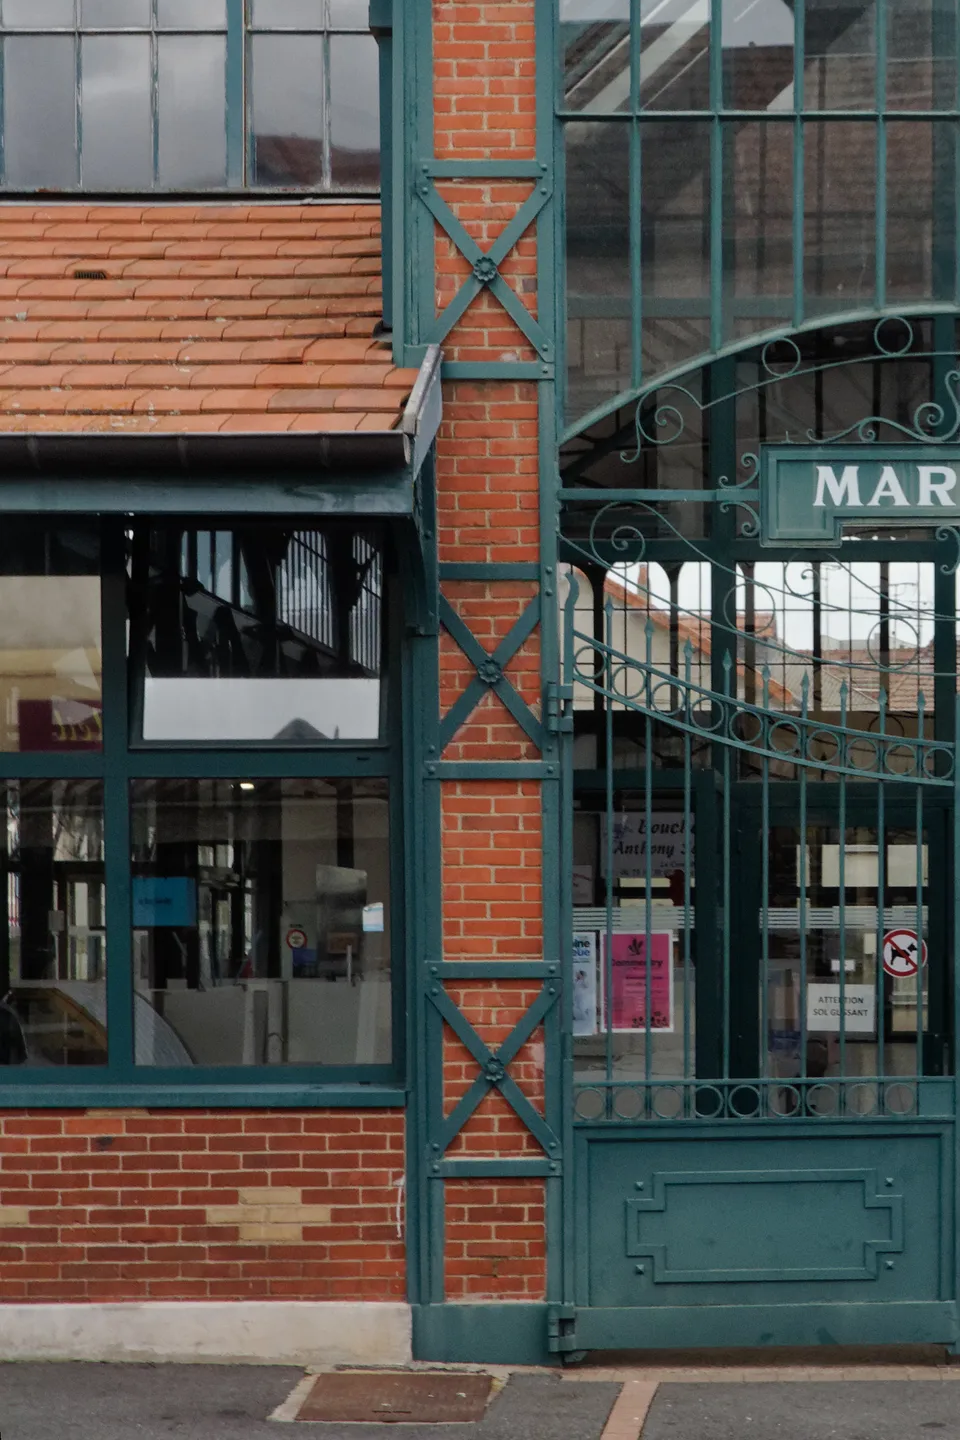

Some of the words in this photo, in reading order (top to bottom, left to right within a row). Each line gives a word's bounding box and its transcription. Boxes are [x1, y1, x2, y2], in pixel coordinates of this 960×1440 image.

[818, 996, 864, 1004] ATTETION
[813, 1008, 828, 1017] SOL
[830, 1008, 868, 1017] GLSSANT
